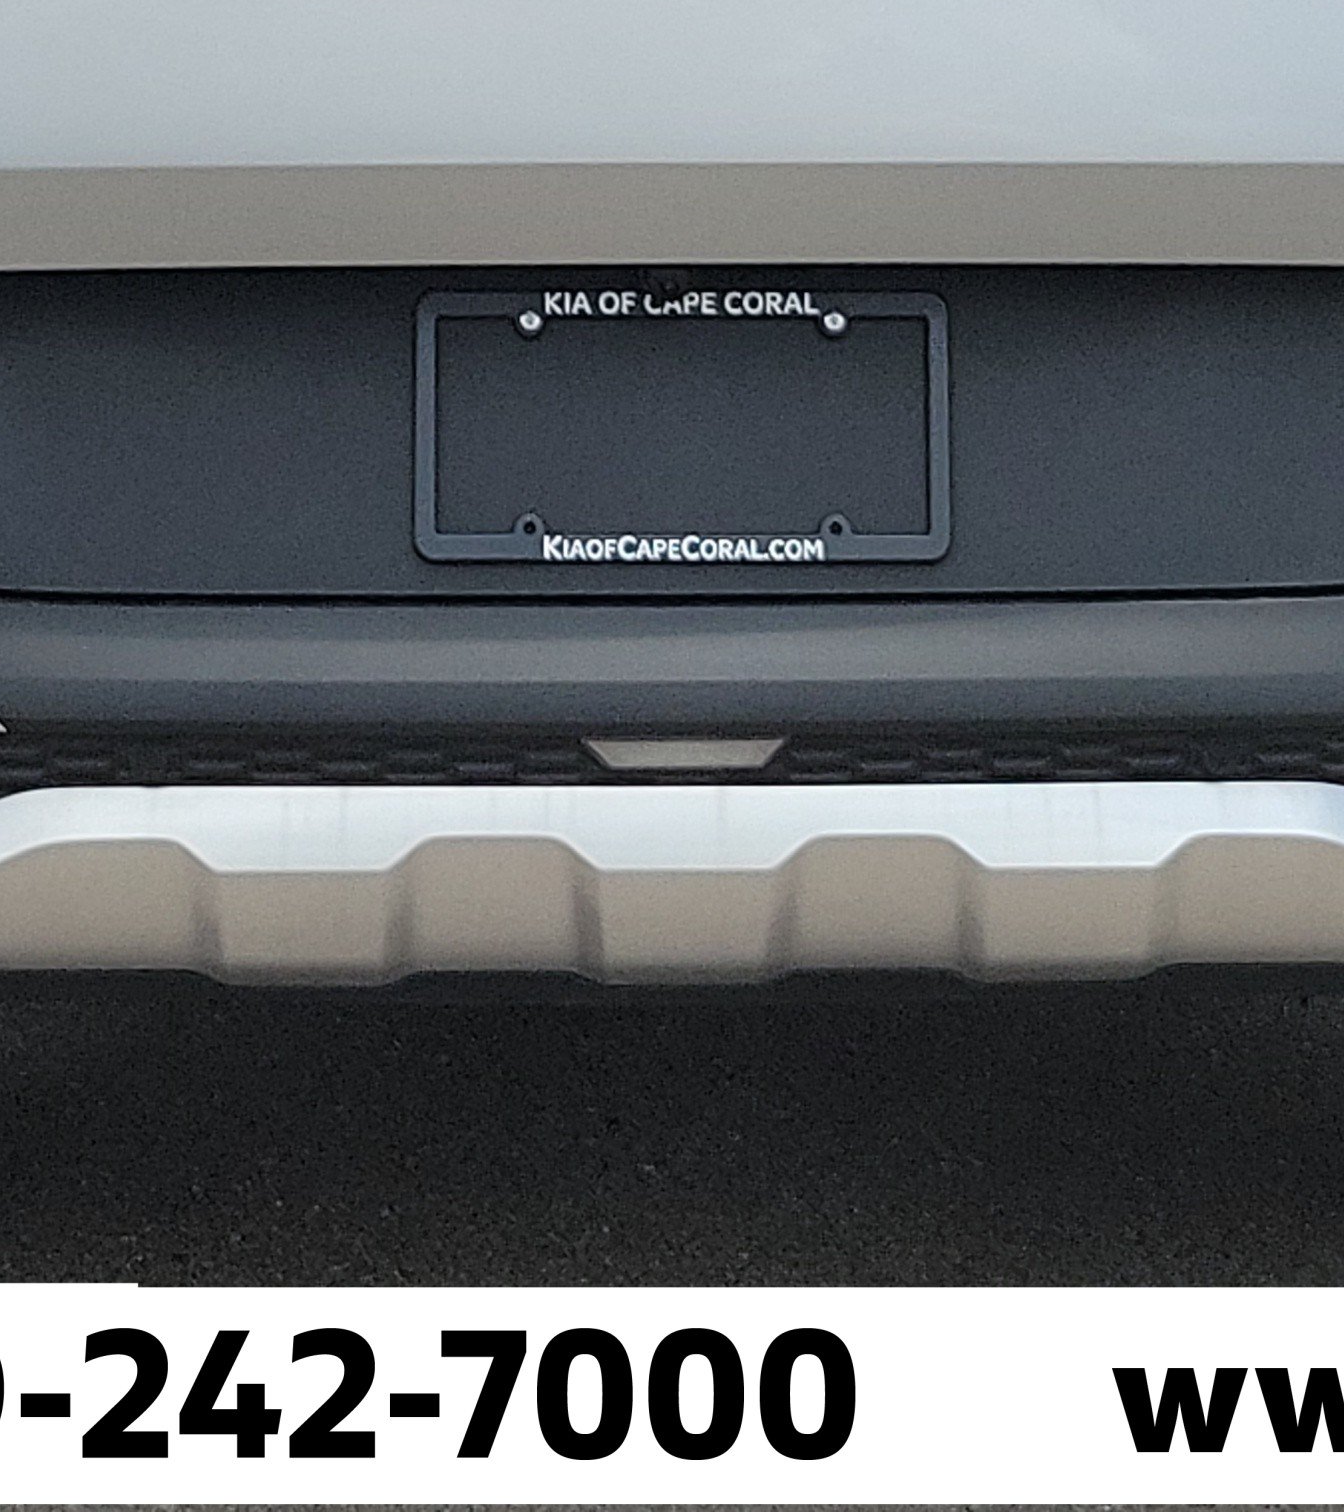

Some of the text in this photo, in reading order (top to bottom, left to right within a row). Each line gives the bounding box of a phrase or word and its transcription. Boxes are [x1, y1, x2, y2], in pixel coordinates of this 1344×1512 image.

[543, 291, 592, 316] KIA
[598, 291, 638, 316] OF
[723, 291, 820, 316] CORAL
